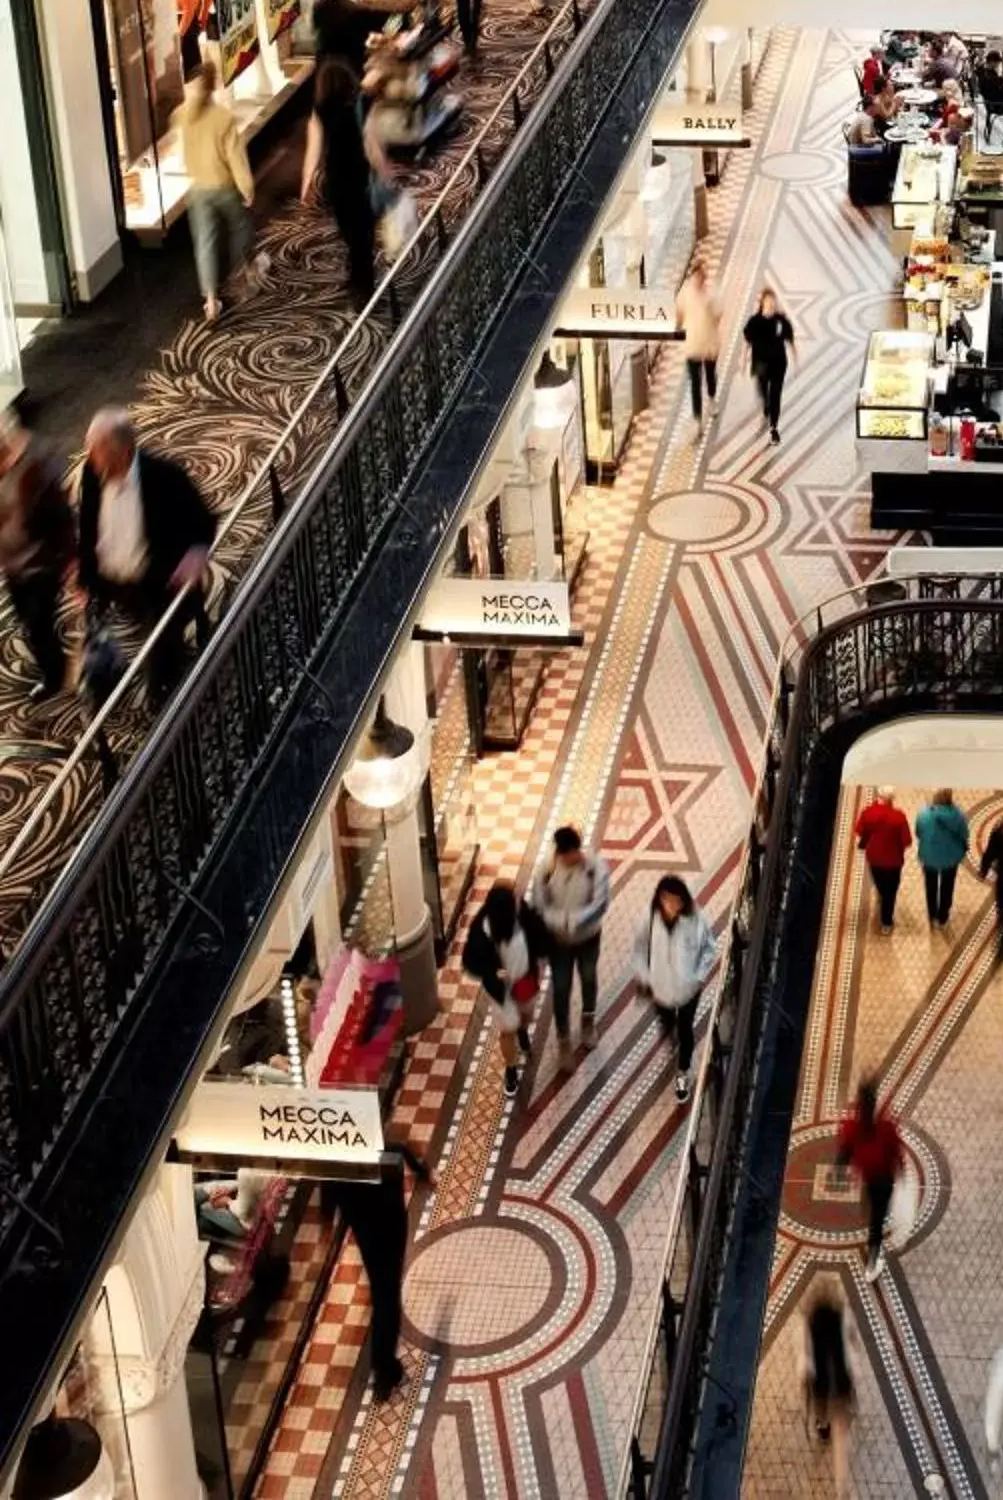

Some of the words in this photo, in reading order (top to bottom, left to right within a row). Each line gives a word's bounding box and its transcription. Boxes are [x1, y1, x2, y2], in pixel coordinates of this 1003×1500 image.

[683, 117, 736, 129] BALLY
[591, 303, 667, 320] FURLA
[481, 595, 552, 611] MECCA
[483, 612, 560, 626] MAXIMA
[259, 1105, 356, 1127] MECCA
[263, 1127, 367, 1147] MAXIMA
